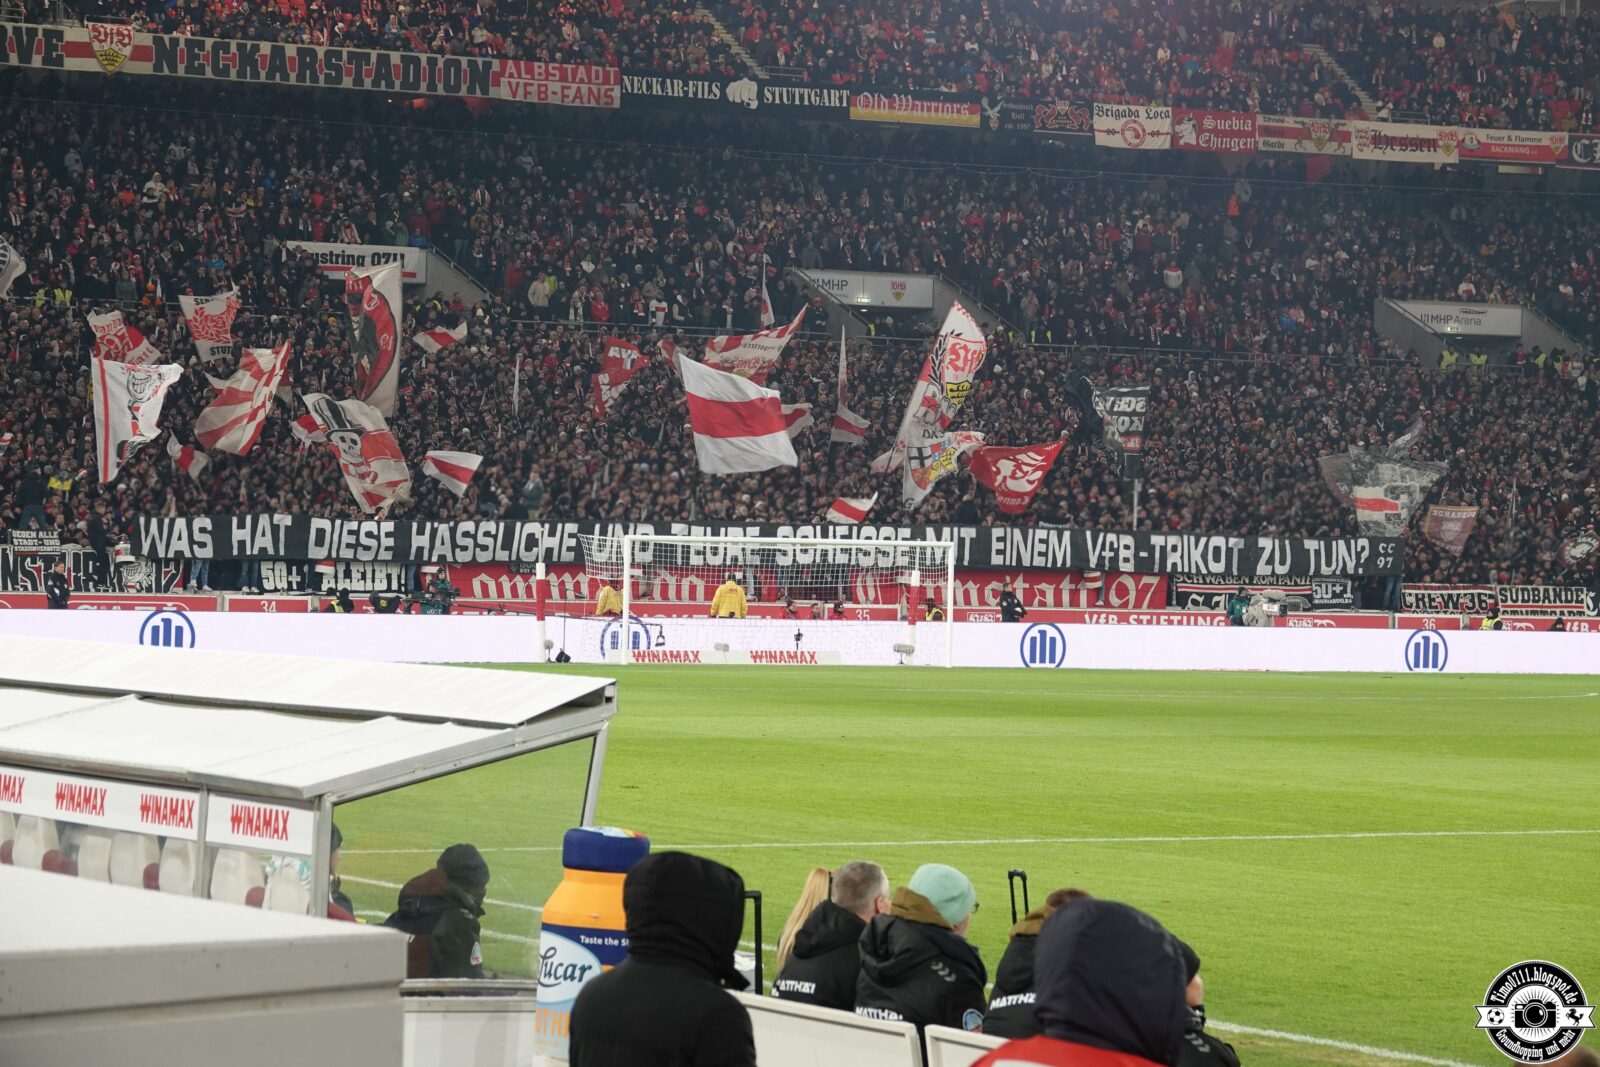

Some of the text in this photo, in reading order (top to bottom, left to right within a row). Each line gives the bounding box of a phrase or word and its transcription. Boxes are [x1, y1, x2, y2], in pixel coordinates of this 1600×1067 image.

[153, 36, 492, 96] NECKARSTADION
[504, 60, 619, 84] ALBSTADT
[507, 81, 614, 106] VFB-FANS
[622, 75, 849, 107] NECKAR-FILS STUTTGART
[857, 92, 970, 118] Old Warriors
[1095, 103, 1171, 120] Brigada Loca
[1202, 115, 1252, 131] Suebia
[1369, 129, 1438, 154] Hessen
[1486, 134, 1506, 142] Feuer
[1515, 135, 1543, 144] Flamme
[1491, 145, 1530, 154] BACKNANG
[822, 279, 848, 291] MHP
[1431, 314, 1482, 326] MHP Arena
[12, 530, 59, 538] GEGEN ALLE
[139, 514, 1370, 576] WAS HAT DIESE HÄSSLICHE UND TEURE SCHEISSE MIT EINEM VfB-TRIKOT ZU TUN?
[1378, 543, 1396, 554] CC
[1377, 556, 1393, 568] 97
[320, 561, 406, 592] BLEIBT!
[1175, 573, 1249, 584] SCHWABEN
[1109, 573, 1160, 609] 97
[1312, 580, 1354, 599] 50+1
[1500, 586, 1585, 604] SÜDBANDE
[260, 600, 277, 612] 34
[1402, 592, 1489, 611] CREW 36
[855, 609, 870, 621] 35
[1422, 618, 1436, 630] 36
[632, 650, 701, 663] WINAMAX
[750, 650, 818, 664] WINAMAX
[0, 774, 25, 804] MAX
[55, 782, 107, 817] WINAMAX
[140, 793, 195, 829] WINAMAX
[231, 803, 290, 841] WINAMAX
[580, 935, 603, 945] Taste
[604, 937, 619, 946] the
